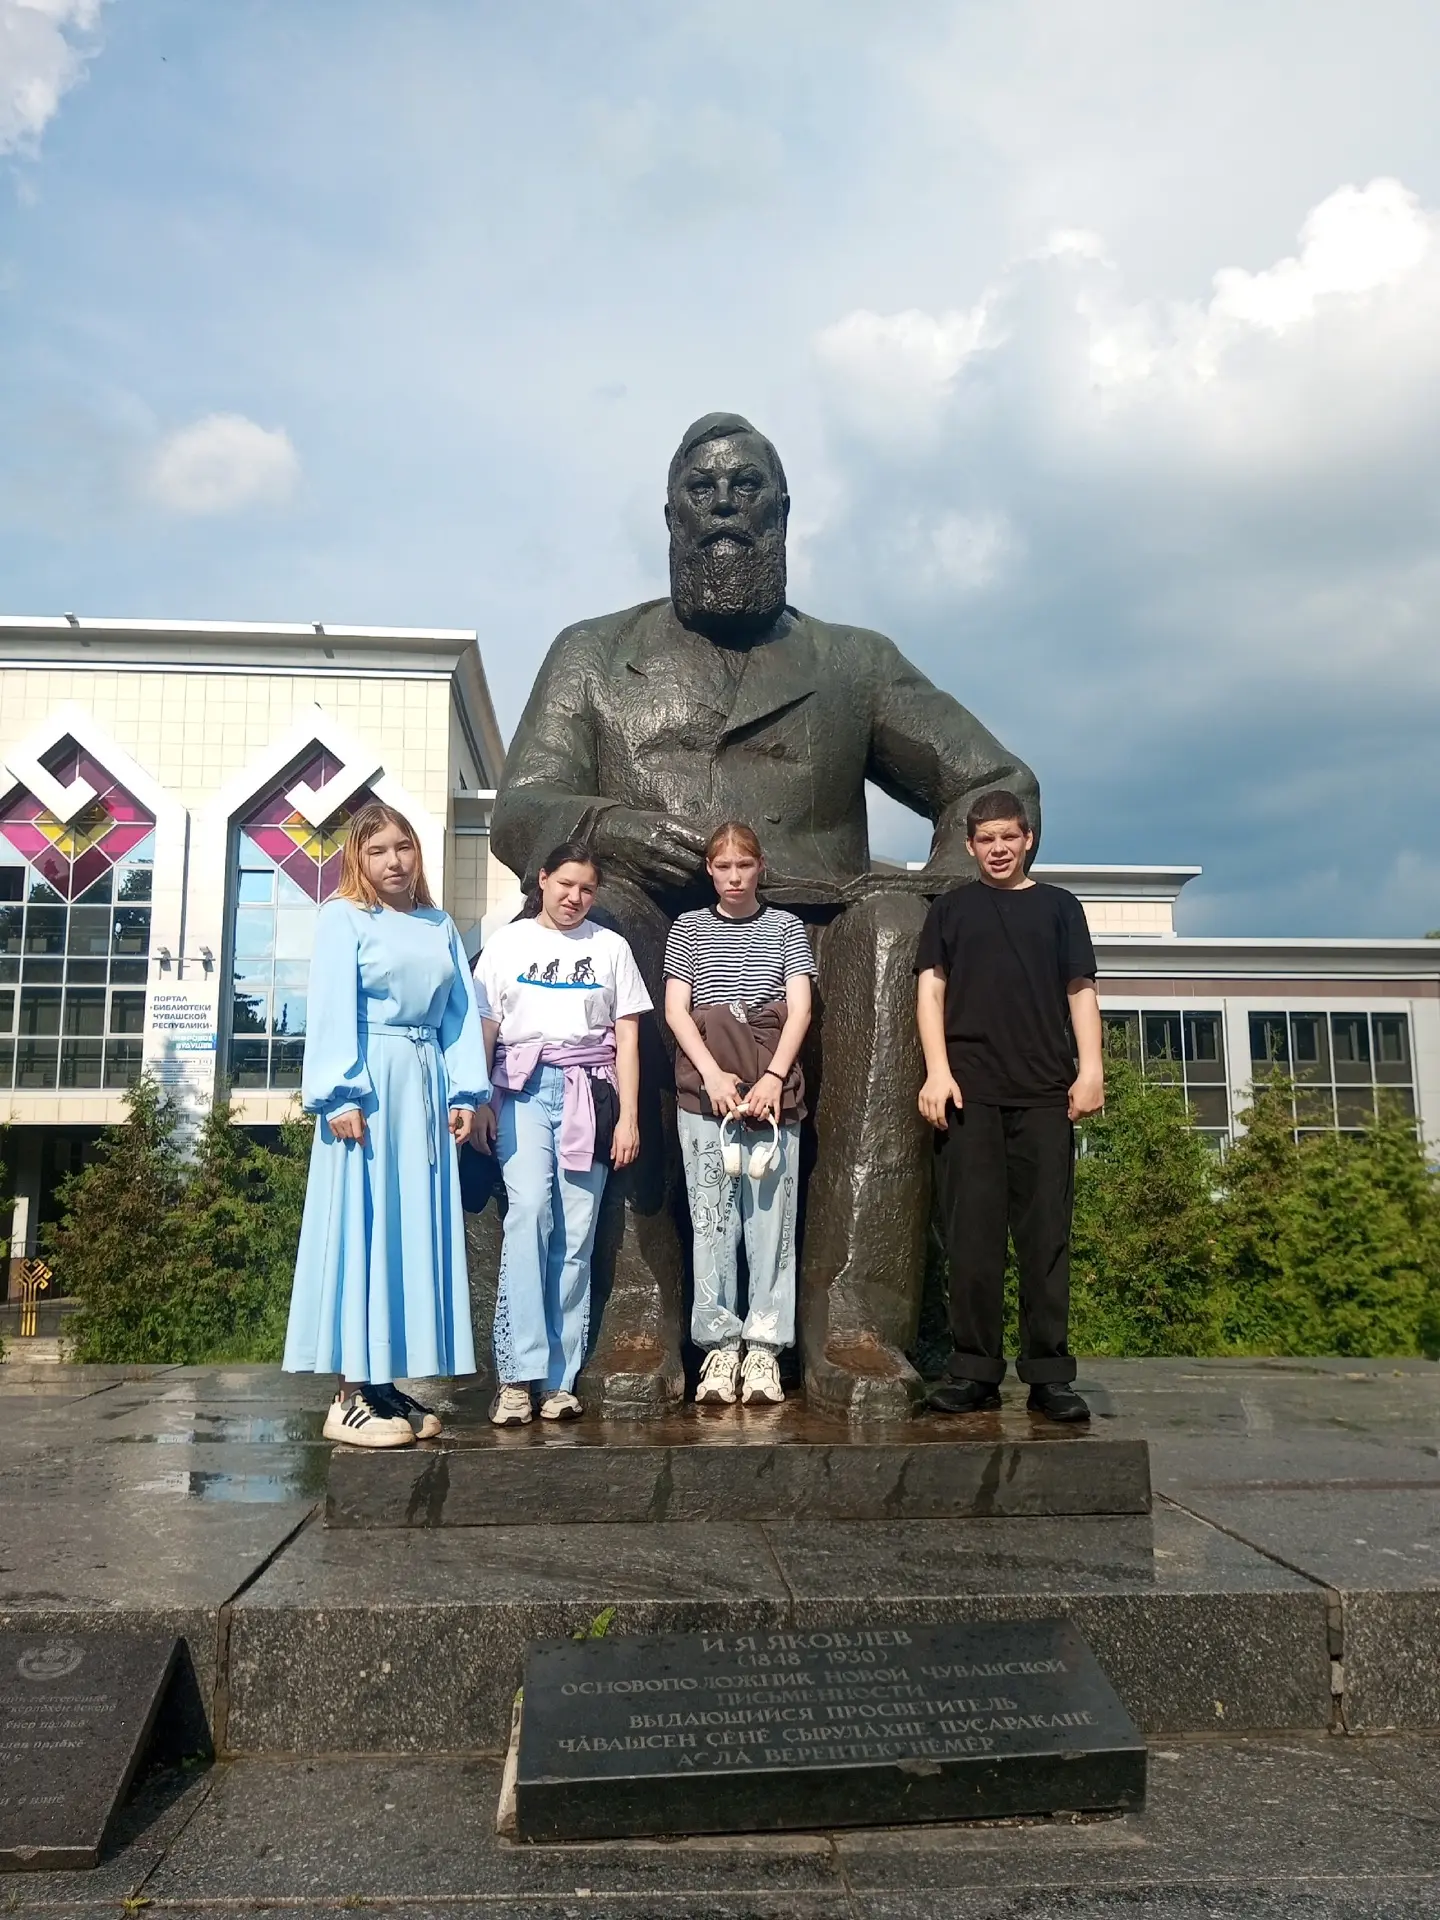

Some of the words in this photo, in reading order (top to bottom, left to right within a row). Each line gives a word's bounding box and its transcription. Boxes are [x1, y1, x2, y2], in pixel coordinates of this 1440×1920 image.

[153, 1012, 208, 1020] ЧУВАШСКОЙ
[766, 1630, 914, 1650] ЯКОВЛЕВ
[737, 1651, 802, 1668] (1848
[825, 1649, 890, 1665] 1930)
[560, 1671, 817, 1696] ОСНОВОПОЛОЖНИК
[824, 1667, 911, 1685] НОВОЙ
[920, 1658, 1070, 1679] ЧУВАШСКОЙ
[715, 1684, 927, 1707] ПИСЬМЕННОСТИ
[628, 1704, 816, 1730] ВЫДАЮЩИЙСЯ
[825, 1695, 1019, 1720] ПРОСВЕТИТЕЛЬ
